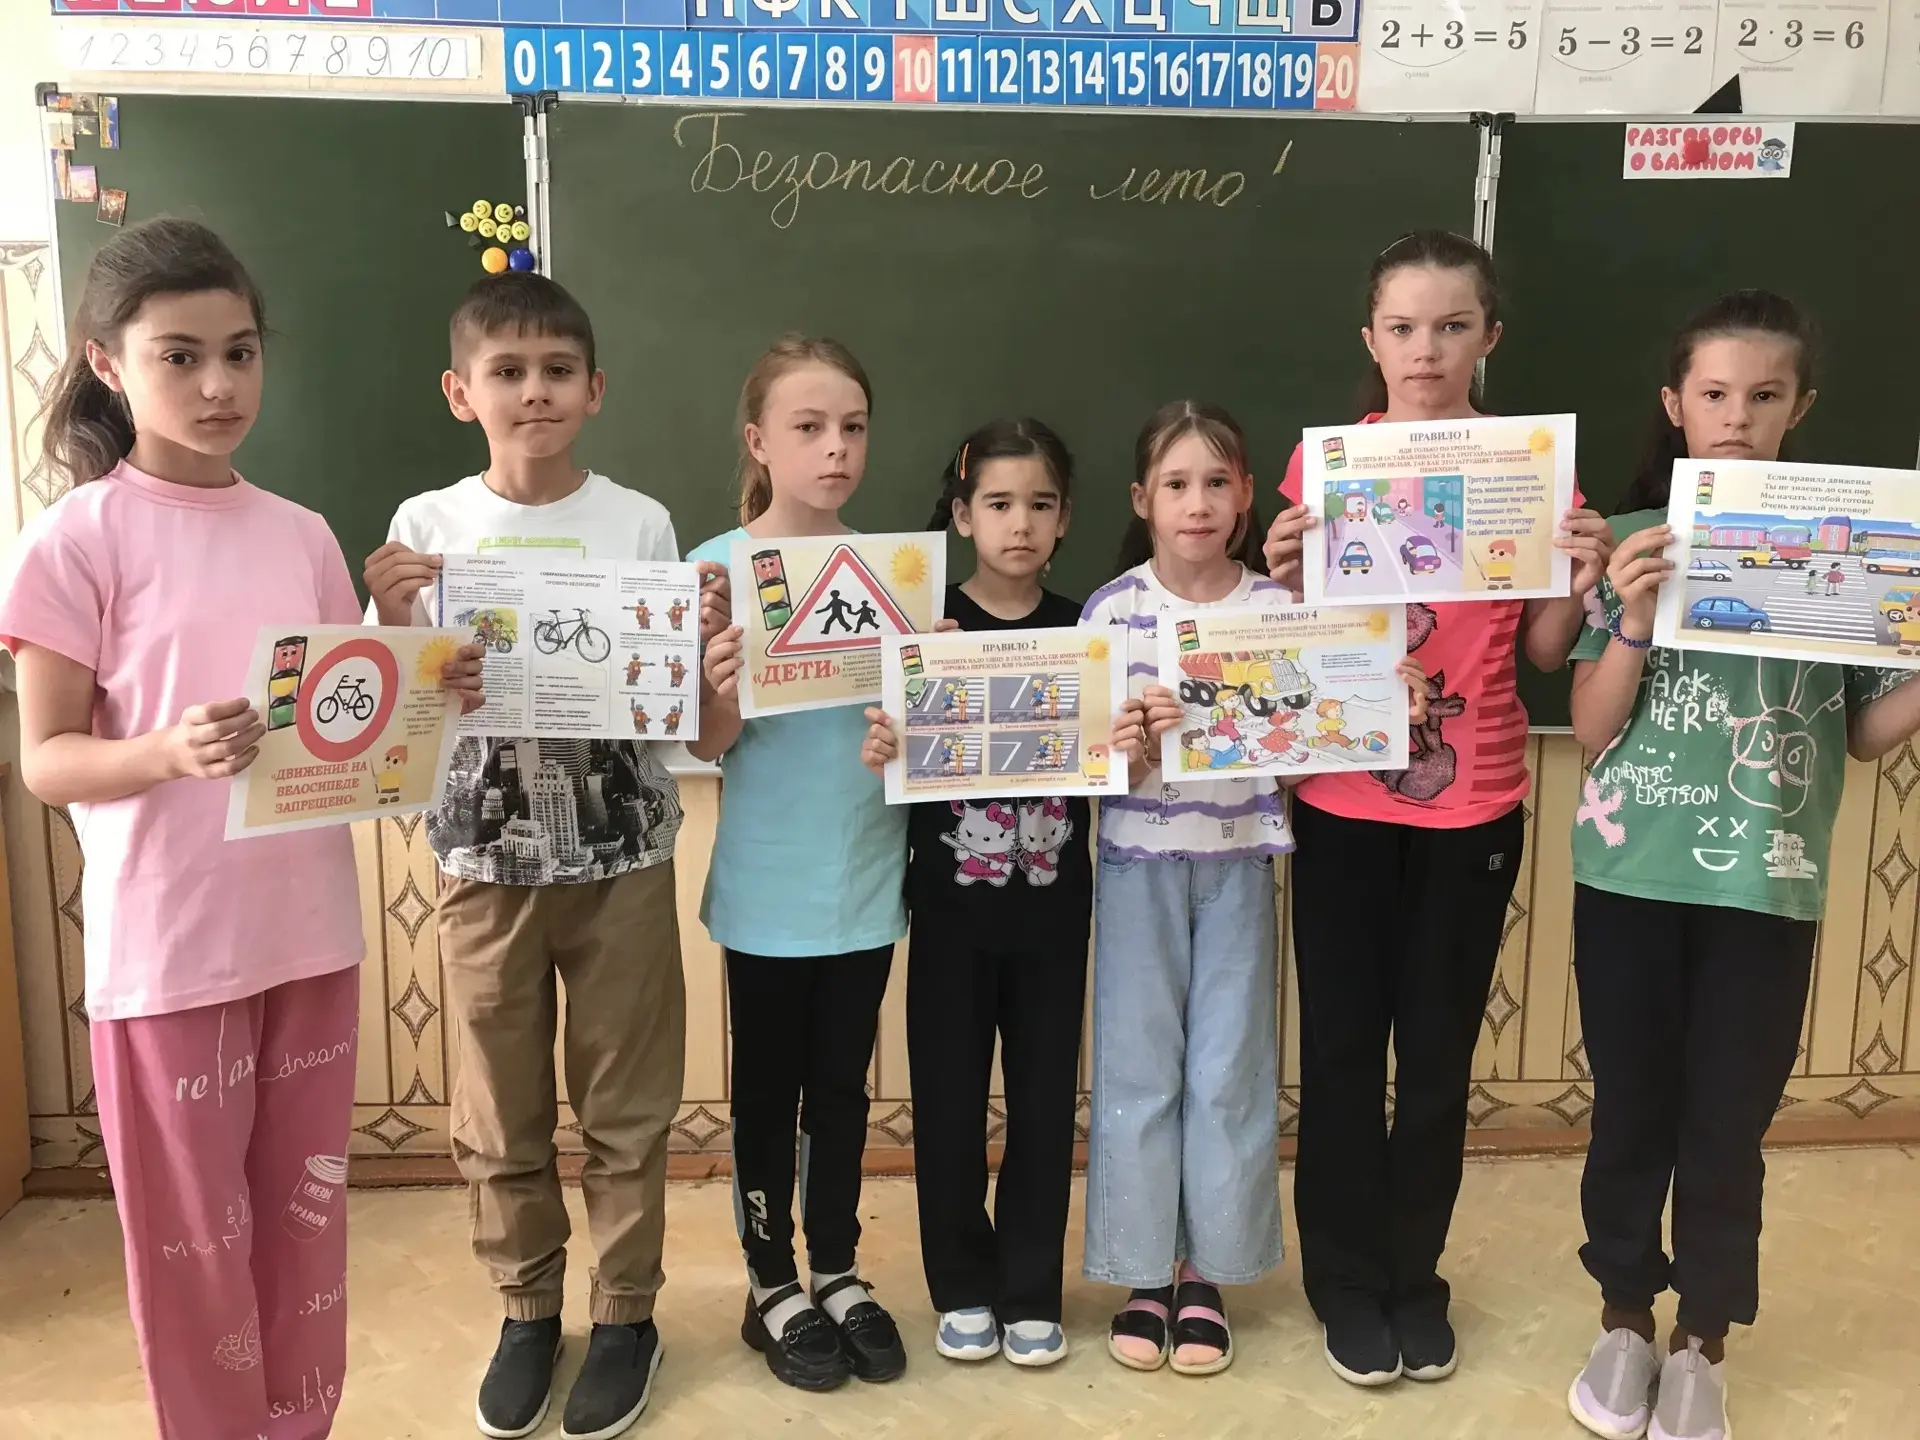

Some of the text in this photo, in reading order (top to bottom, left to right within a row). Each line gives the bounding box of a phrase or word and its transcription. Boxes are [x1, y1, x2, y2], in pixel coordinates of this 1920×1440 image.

[1381, 20, 1400, 48] 2
[1444, 20, 1464, 49] 3
[1507, 20, 1527, 50] 5
[1558, 27, 1577, 56] 5
[1620, 26, 1641, 55] 3
[1683, 26, 1704, 54] 2
[1738, 18, 1758, 47] 2
[1784, 19, 1804, 48] 3
[1845, 21, 1865, 49] 6
[80, 33, 451, 77] 1 2 3 4 5 6 7 8 9 10
[514, 40, 1354, 99] 0 1 2 3 4 5 6 7 8 9 10 11 12 13 14 15 16 17 18 19 20
[673, 111, 1050, 229] Безопасное
[1630, 152, 1646, 171] О
[1409, 429, 1471, 442] ПРАВИЛО 1
[1767, 473, 1872, 486] Если правила движенья
[1761, 502, 1872, 515] Очень нужный разговор!
[1815, 494, 1841, 503] тобой
[1261, 610, 1318, 623] ПРАВИЛО 4
[982, 640, 1037, 652] ПРАВИЛО 2
[1646, 645, 1684, 672] GET
[752, 659, 840, 687] «ДЕТИ»
[1651, 695, 1719, 734] HERE
[271, 761, 368, 782] «ДВИЖЕНИЕ НА
[276, 778, 360, 797] ВЕЛОСИПЕДЕ
